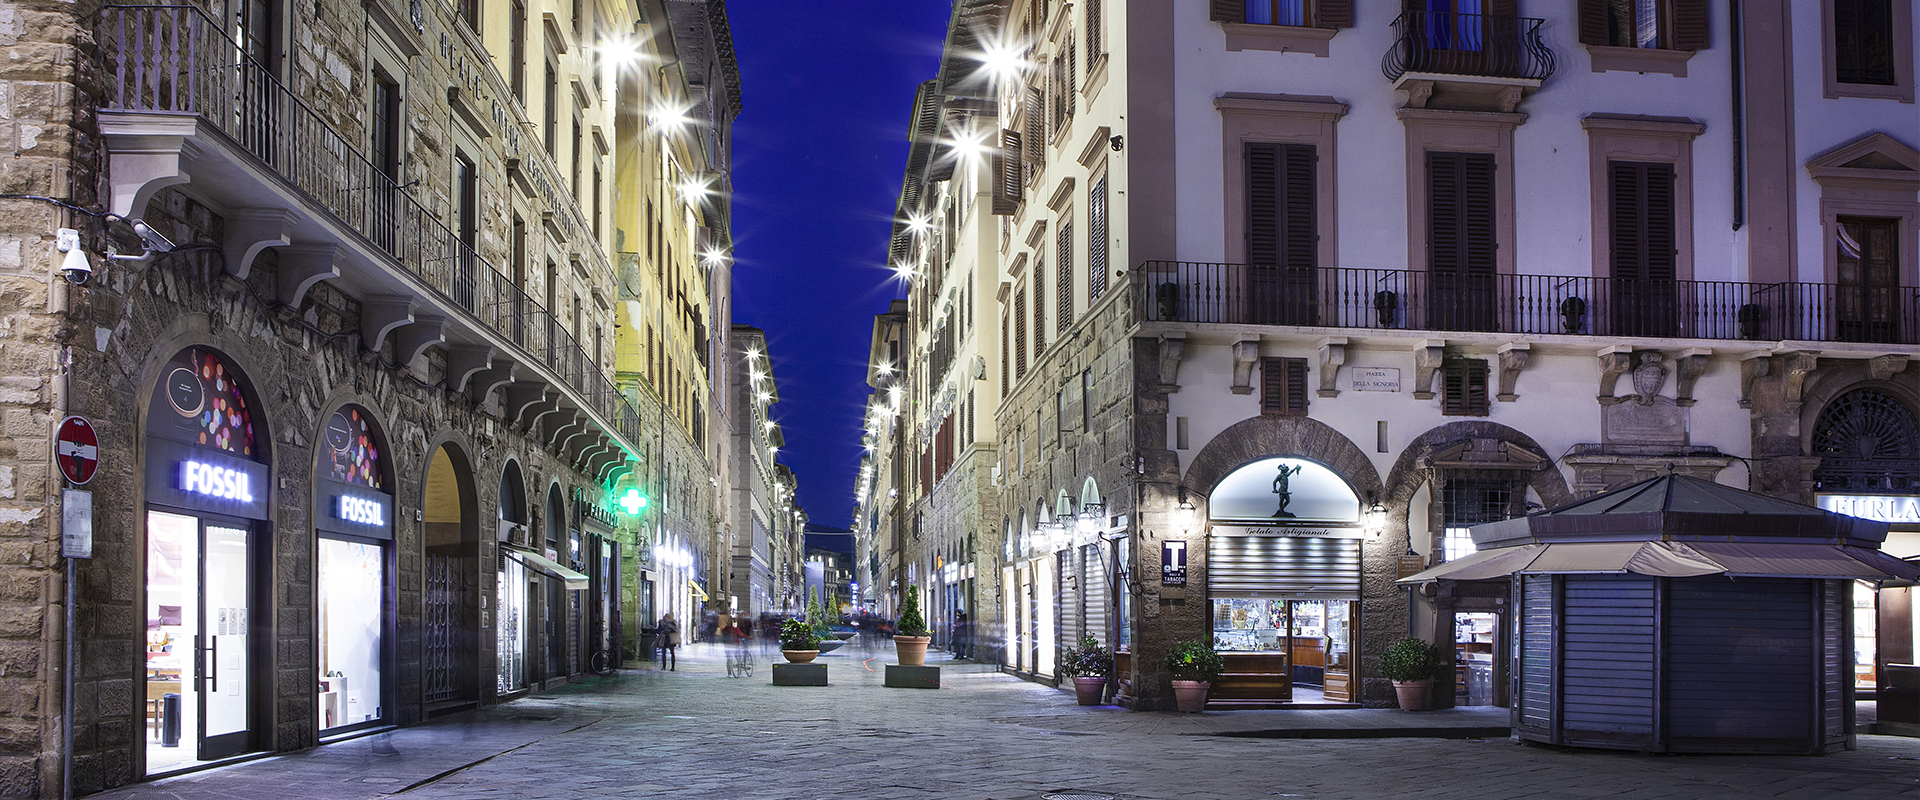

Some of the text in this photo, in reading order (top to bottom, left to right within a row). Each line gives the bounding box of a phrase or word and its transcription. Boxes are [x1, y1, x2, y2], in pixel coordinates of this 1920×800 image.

[186, 460, 253, 502] FOSSIL
[341, 495, 384, 526] FOSSIL
[1836, 500, 1920, 518] FURLA
[1245, 526, 1331, 537] Gelato Artigianale
[1166, 542, 1184, 571] T
